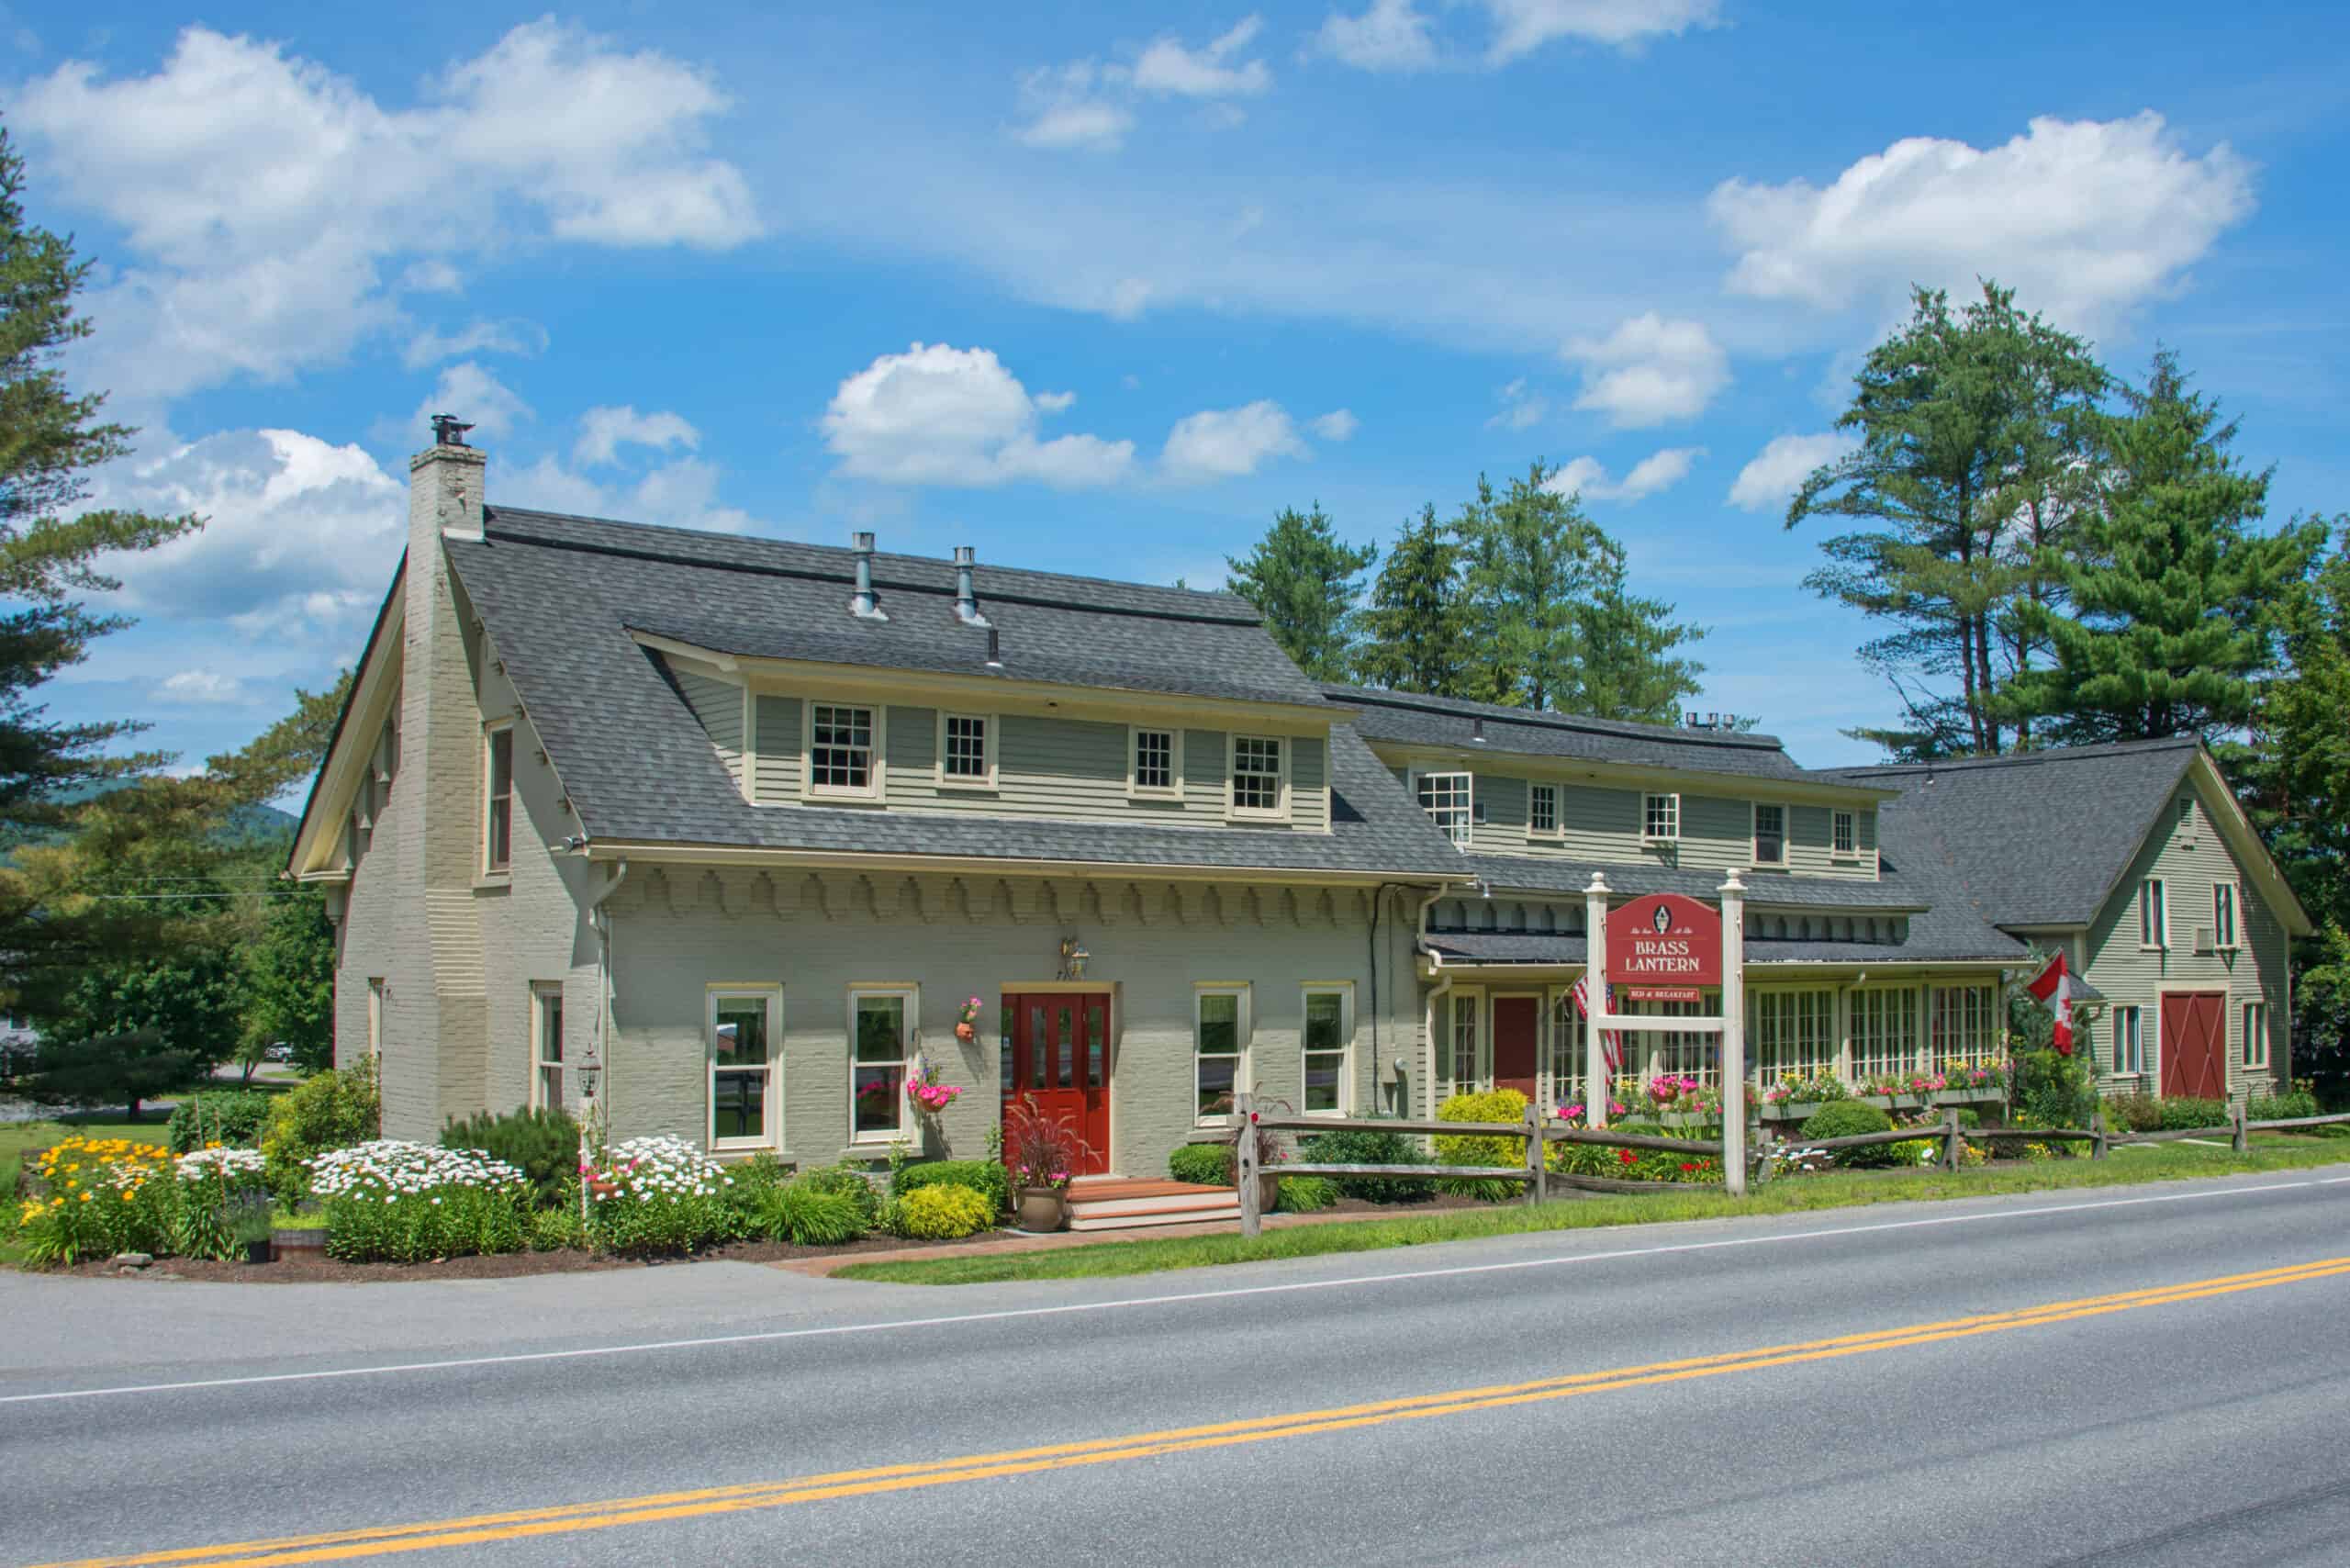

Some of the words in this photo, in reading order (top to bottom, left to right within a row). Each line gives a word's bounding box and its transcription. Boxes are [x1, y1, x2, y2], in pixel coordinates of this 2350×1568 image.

[1635, 940, 1690, 956] BRASS
[1625, 957, 1700, 971] LANTERN
[1655, 991, 1695, 999] BREAKFAST
